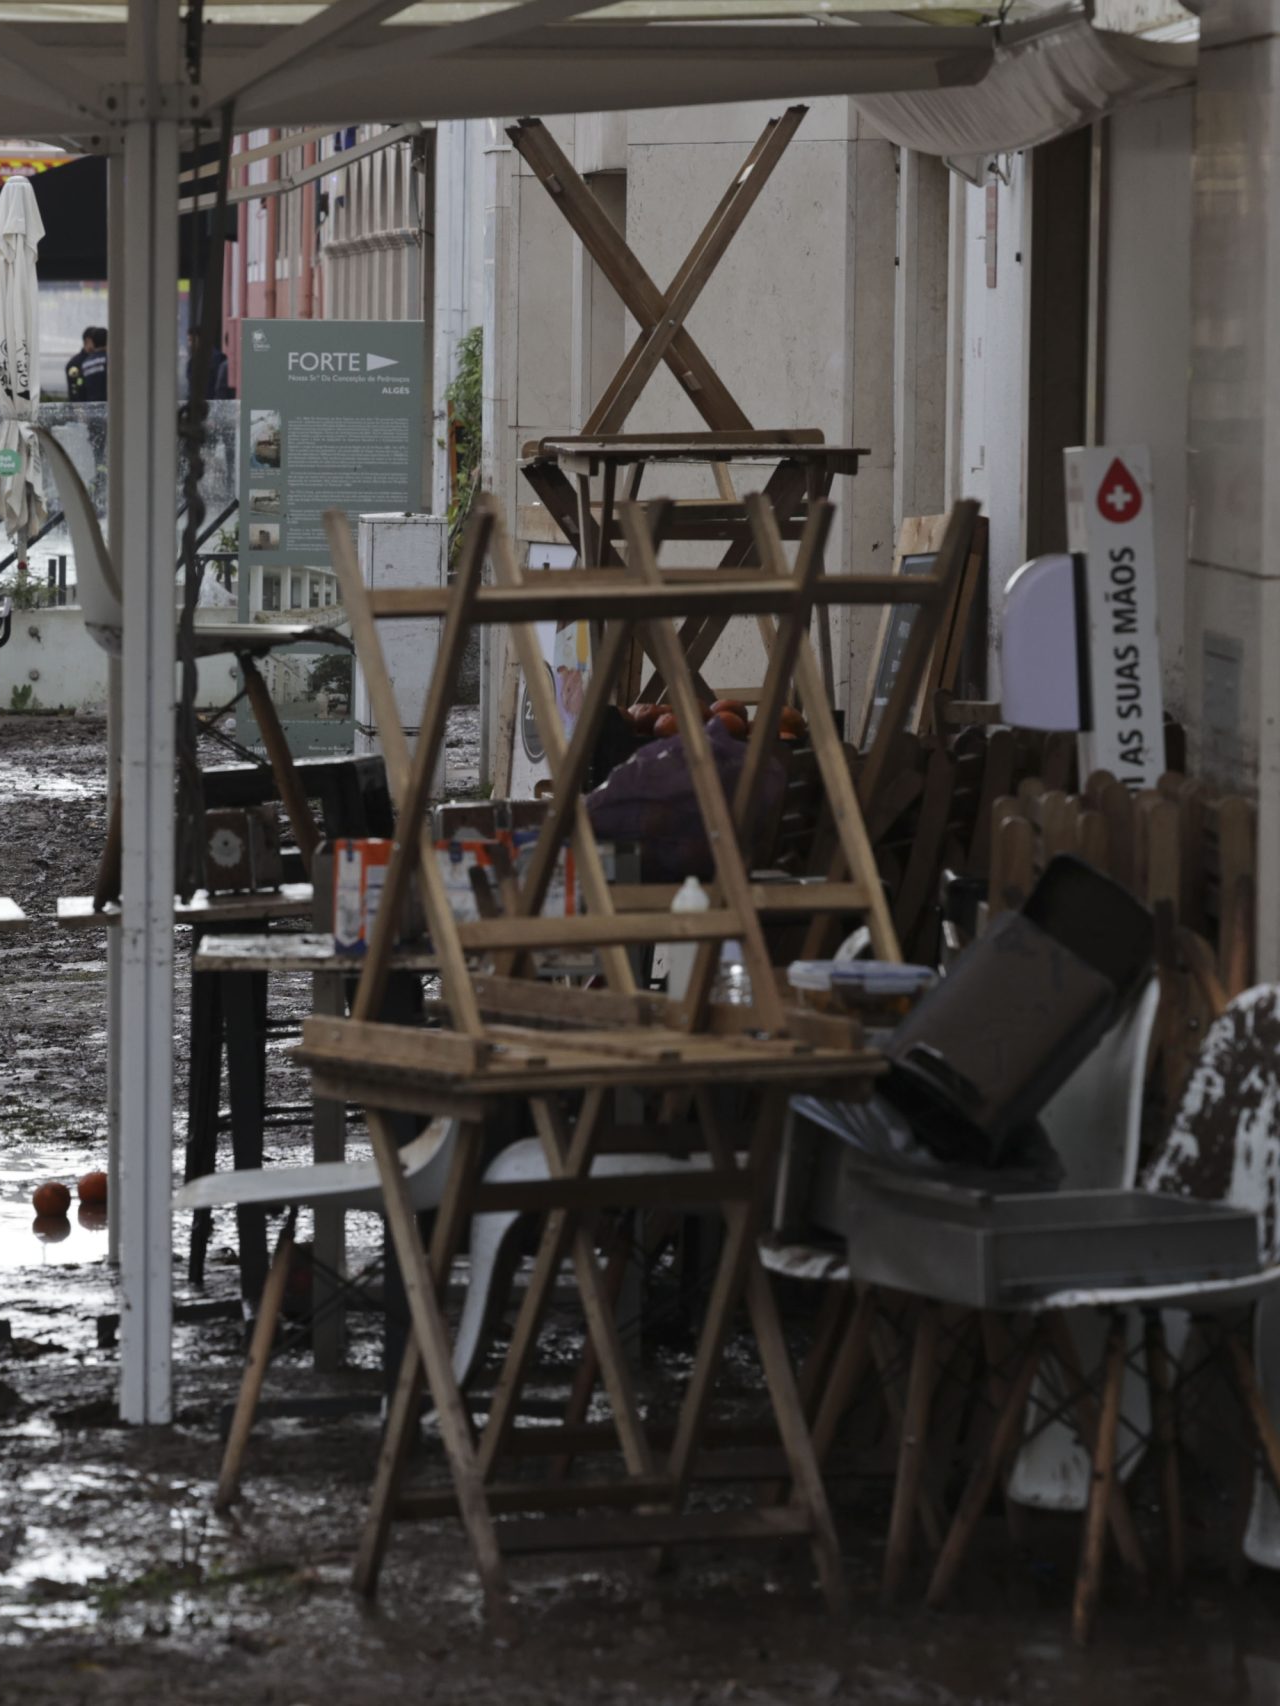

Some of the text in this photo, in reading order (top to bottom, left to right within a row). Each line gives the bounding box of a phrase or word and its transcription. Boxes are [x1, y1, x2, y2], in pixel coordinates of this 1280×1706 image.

[288, 352, 360, 371] FORTE
[382, 386, 410, 395] ALGÉS
[1104, 546, 1139, 635] MÃOS
[1115, 644, 1143, 719] SUAS
[1119, 729, 1146, 767] AS
